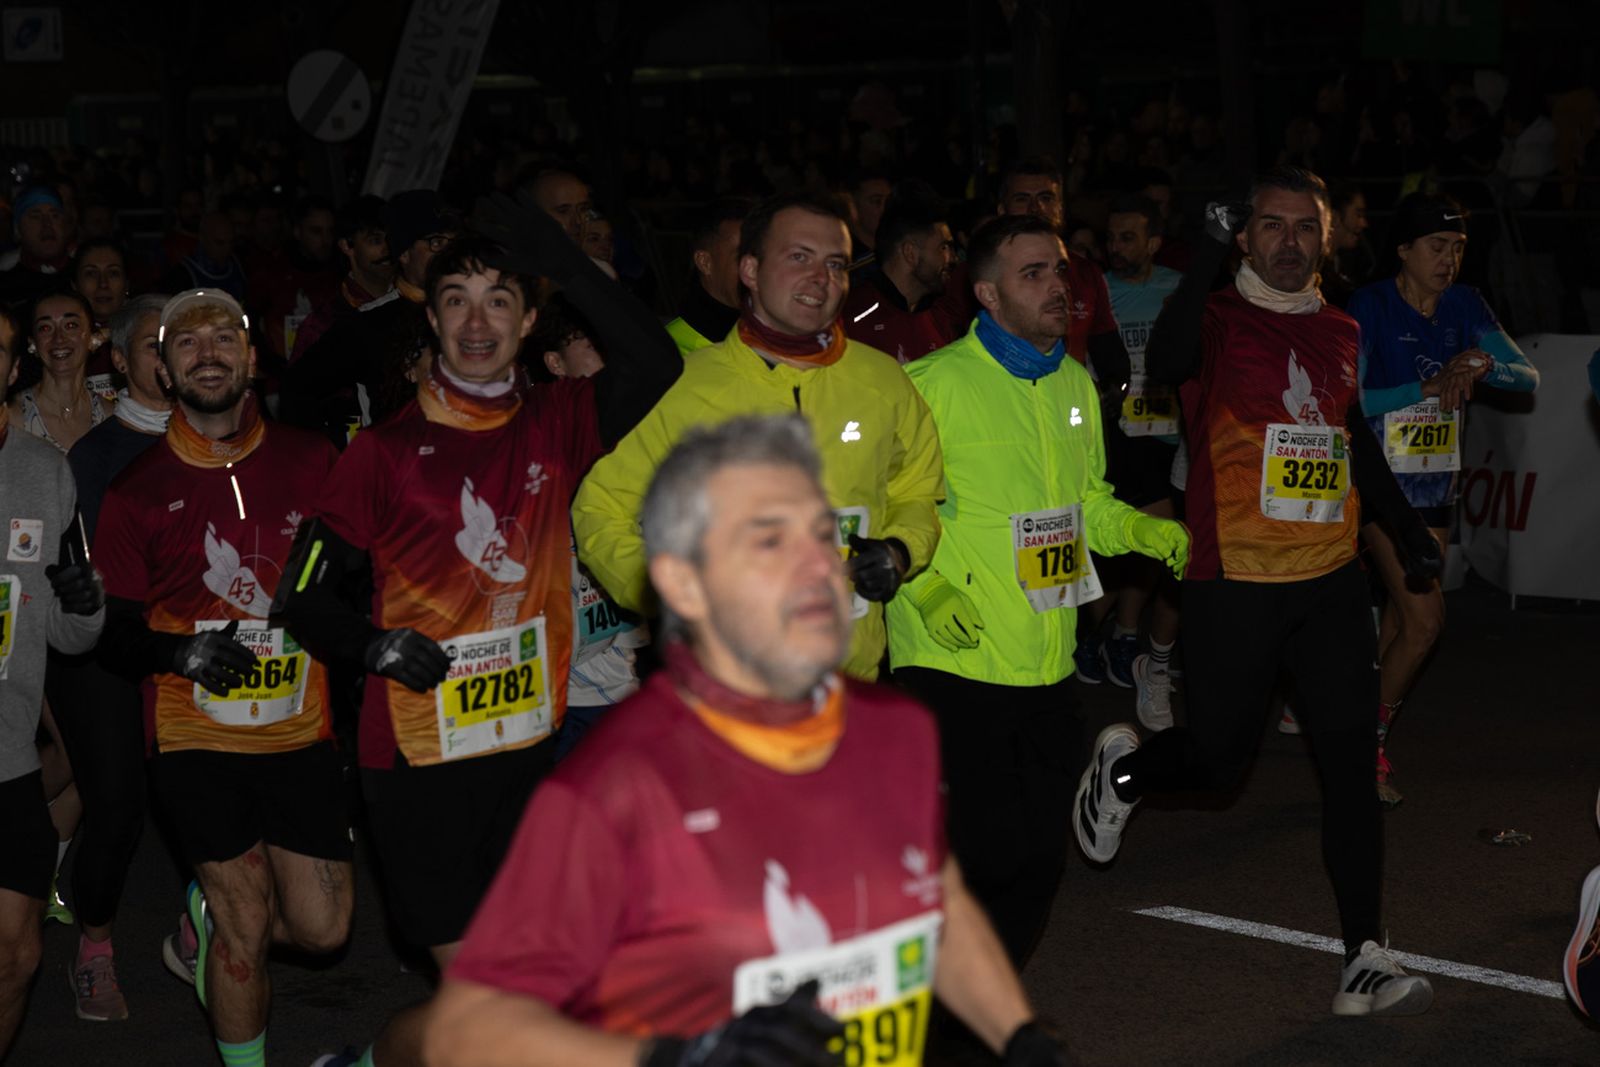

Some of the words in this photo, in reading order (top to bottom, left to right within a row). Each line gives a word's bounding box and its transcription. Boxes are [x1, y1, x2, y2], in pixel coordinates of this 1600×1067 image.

[1290, 436, 1317, 447] NOCHE
[1318, 437, 1328, 447] DE
[1399, 424, 1449, 447] 12617
[1276, 446, 1297, 457] SAN
[1282, 460, 1339, 490] 3232
[1463, 449, 1537, 531] ÓN
[1035, 519, 1063, 533] NOCHE
[1024, 535, 1044, 548] SAN
[228, 577, 256, 605] 43
[233, 632, 259, 644] OCHE
[260, 633, 273, 643] DE
[246, 643, 273, 657] TÓN
[460, 644, 498, 661] NOCHE
[500, 641, 512, 655] DE
[242, 657, 298, 689] 664
[447, 663, 474, 679] SAN
[456, 665, 535, 714] 12782
[842, 1001, 919, 1067] 897
